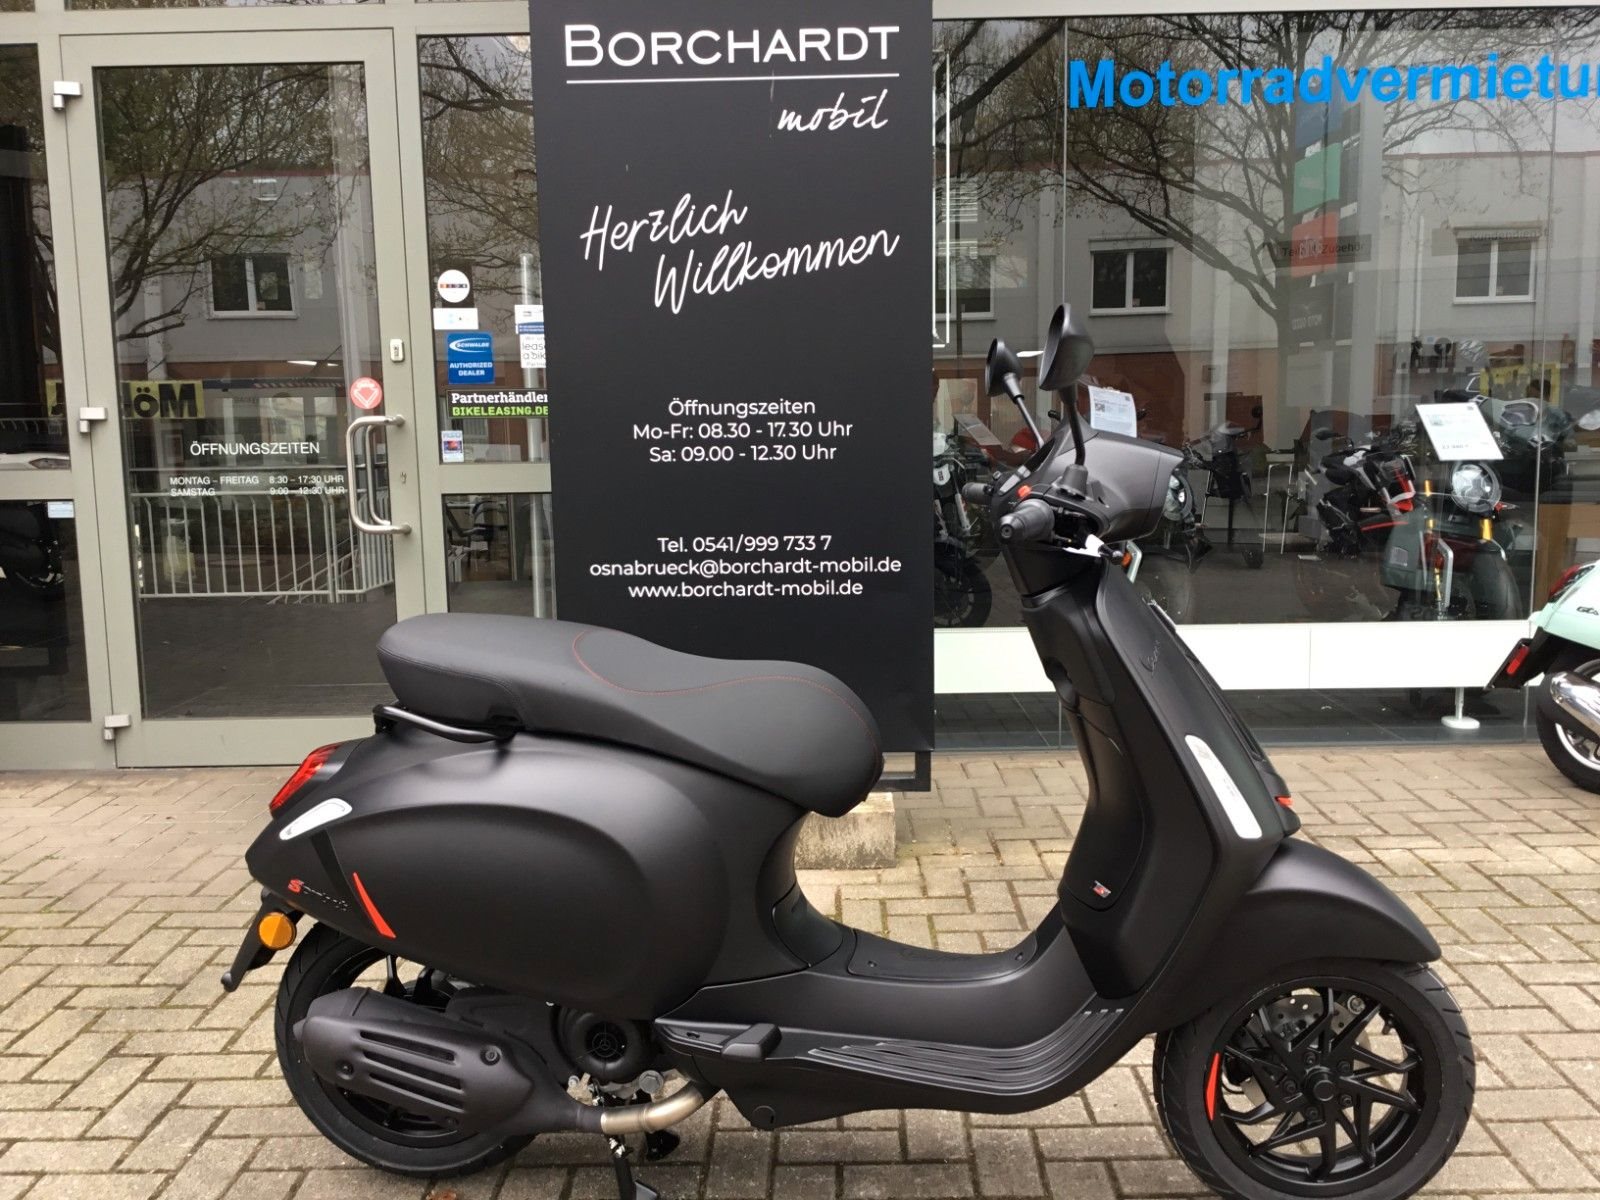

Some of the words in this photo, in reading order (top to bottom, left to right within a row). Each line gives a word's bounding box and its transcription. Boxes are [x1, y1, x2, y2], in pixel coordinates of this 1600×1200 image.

[1069, 52, 1600, 109] Motorradvermietu
[777, 88, 888, 132] mobil
[580, 189, 748, 271] Herzlich
[654, 229, 900, 314] Willkommen
[521, 342, 546, 351] leas
[452, 405, 549, 416] BIKELEASING.DE
[667, 397, 816, 419] Öffnungszeiten
[633, 423, 694, 440] Mo-Fr:
[697, 421, 751, 439] 08.30
[766, 421, 813, 438] 17.30
[817, 420, 854, 437] Uhr
[190, 440, 320, 456] ÖFFNUNGSZEITEN
[649, 446, 677, 463] Sa:
[680, 445, 735, 462] 09.00
[750, 444, 797, 461] 12.30
[802, 443, 837, 461] Uhr
[169, 476, 211, 486] MONTAG
[220, 475, 260, 485] FREITAG
[298, 475, 322, 484] 17:30
[323, 474, 345, 483] UHR
[170, 487, 216, 497] SAMSTAG
[324, 486, 345, 495] UHR
[656, 536, 689, 553] Tel.
[692, 533, 780, 554] 0541/999
[782, 535, 817, 551] 733
[820, 534, 832, 551] 7
[589, 556, 902, 579] osnabrueck@borchardt-mobil.de
[627, 578, 864, 598] www.borchardt-mobil.de
